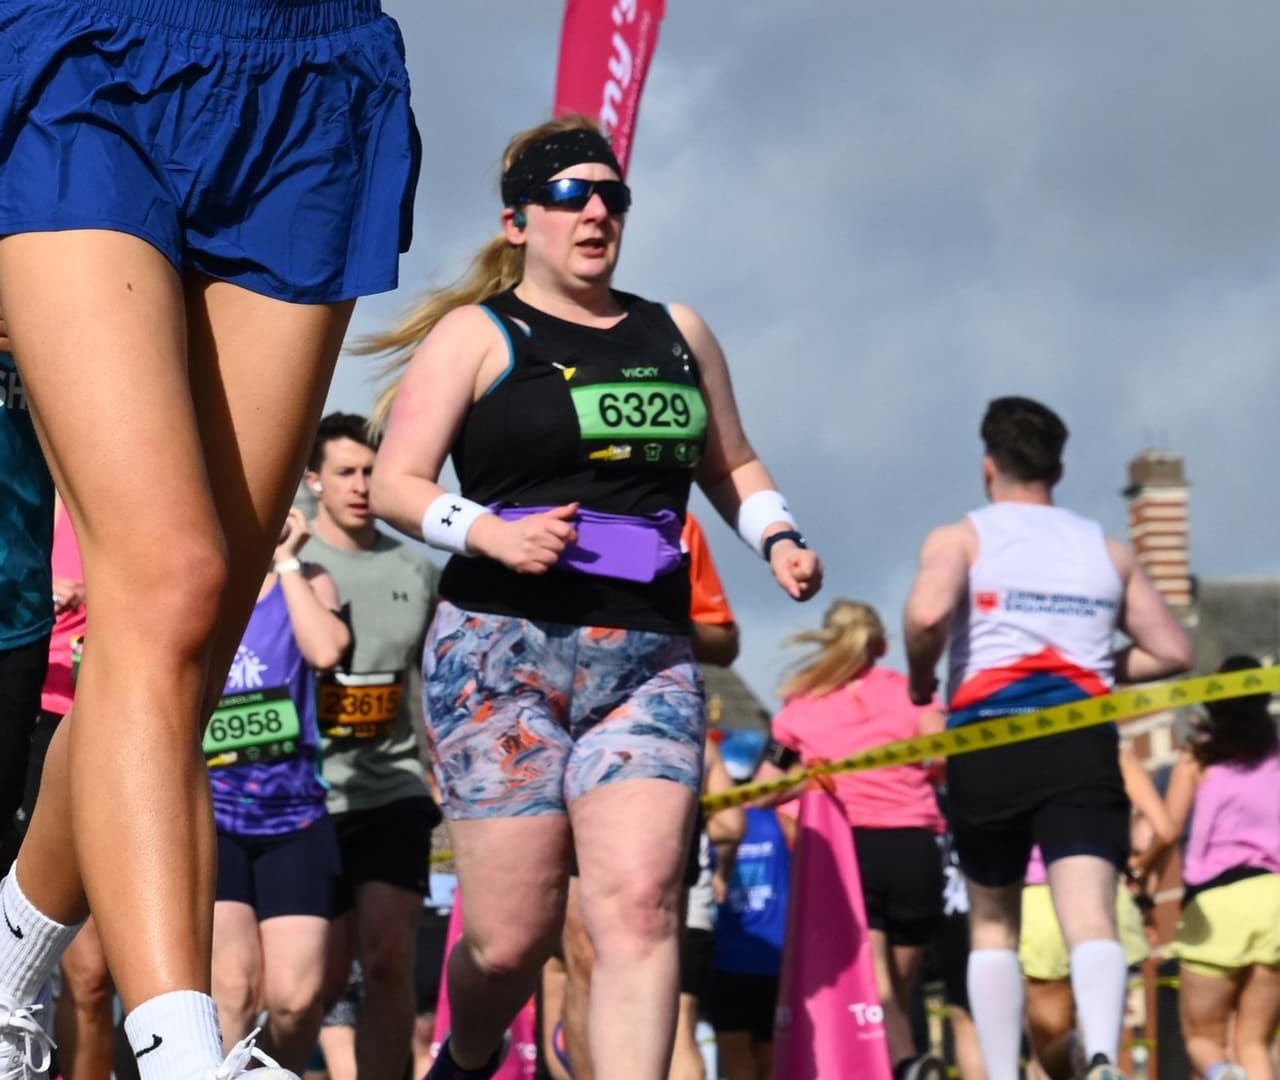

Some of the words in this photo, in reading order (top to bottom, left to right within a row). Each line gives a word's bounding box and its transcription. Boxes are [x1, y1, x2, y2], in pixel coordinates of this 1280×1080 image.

[621, 367, 659, 378] VICKY
[598, 392, 691, 428] 6329
[209, 708, 283, 743] 6958
